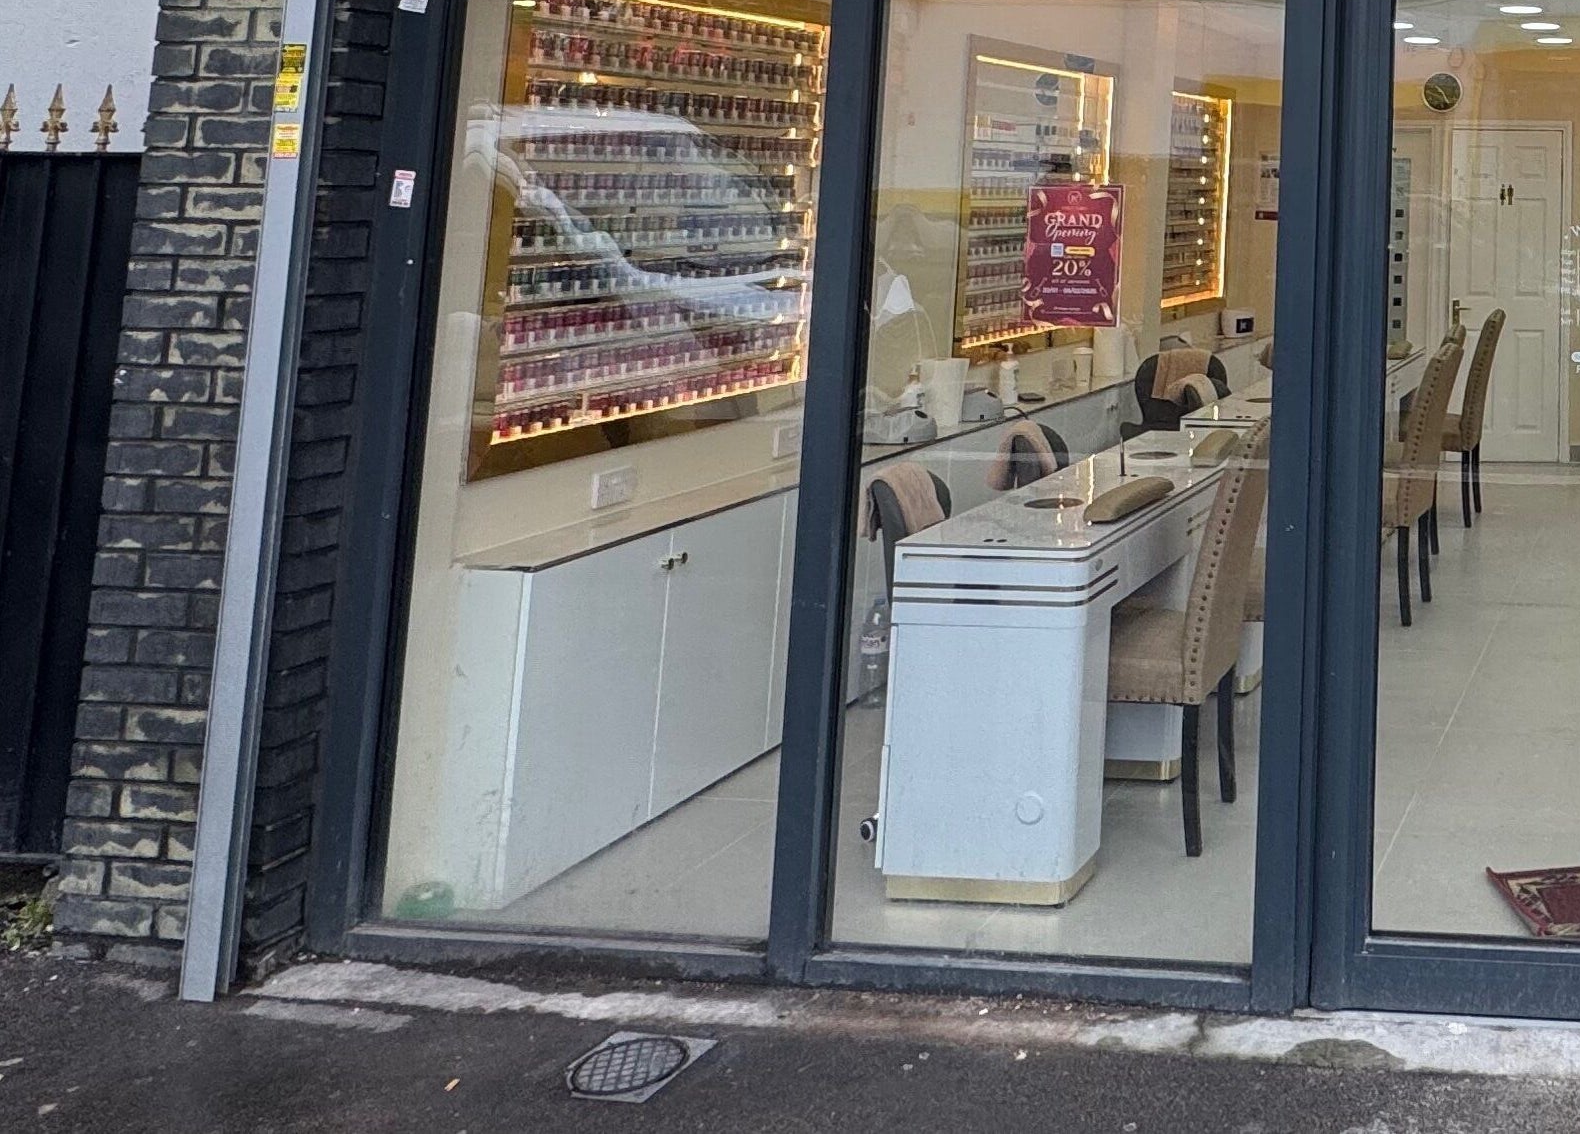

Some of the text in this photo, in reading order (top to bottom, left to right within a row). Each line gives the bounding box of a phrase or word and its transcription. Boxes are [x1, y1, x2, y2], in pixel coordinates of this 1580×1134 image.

[1044, 211, 1103, 228] GRAND
[1045, 223, 1098, 245] Opening
[1052, 259, 1092, 277] 20%
